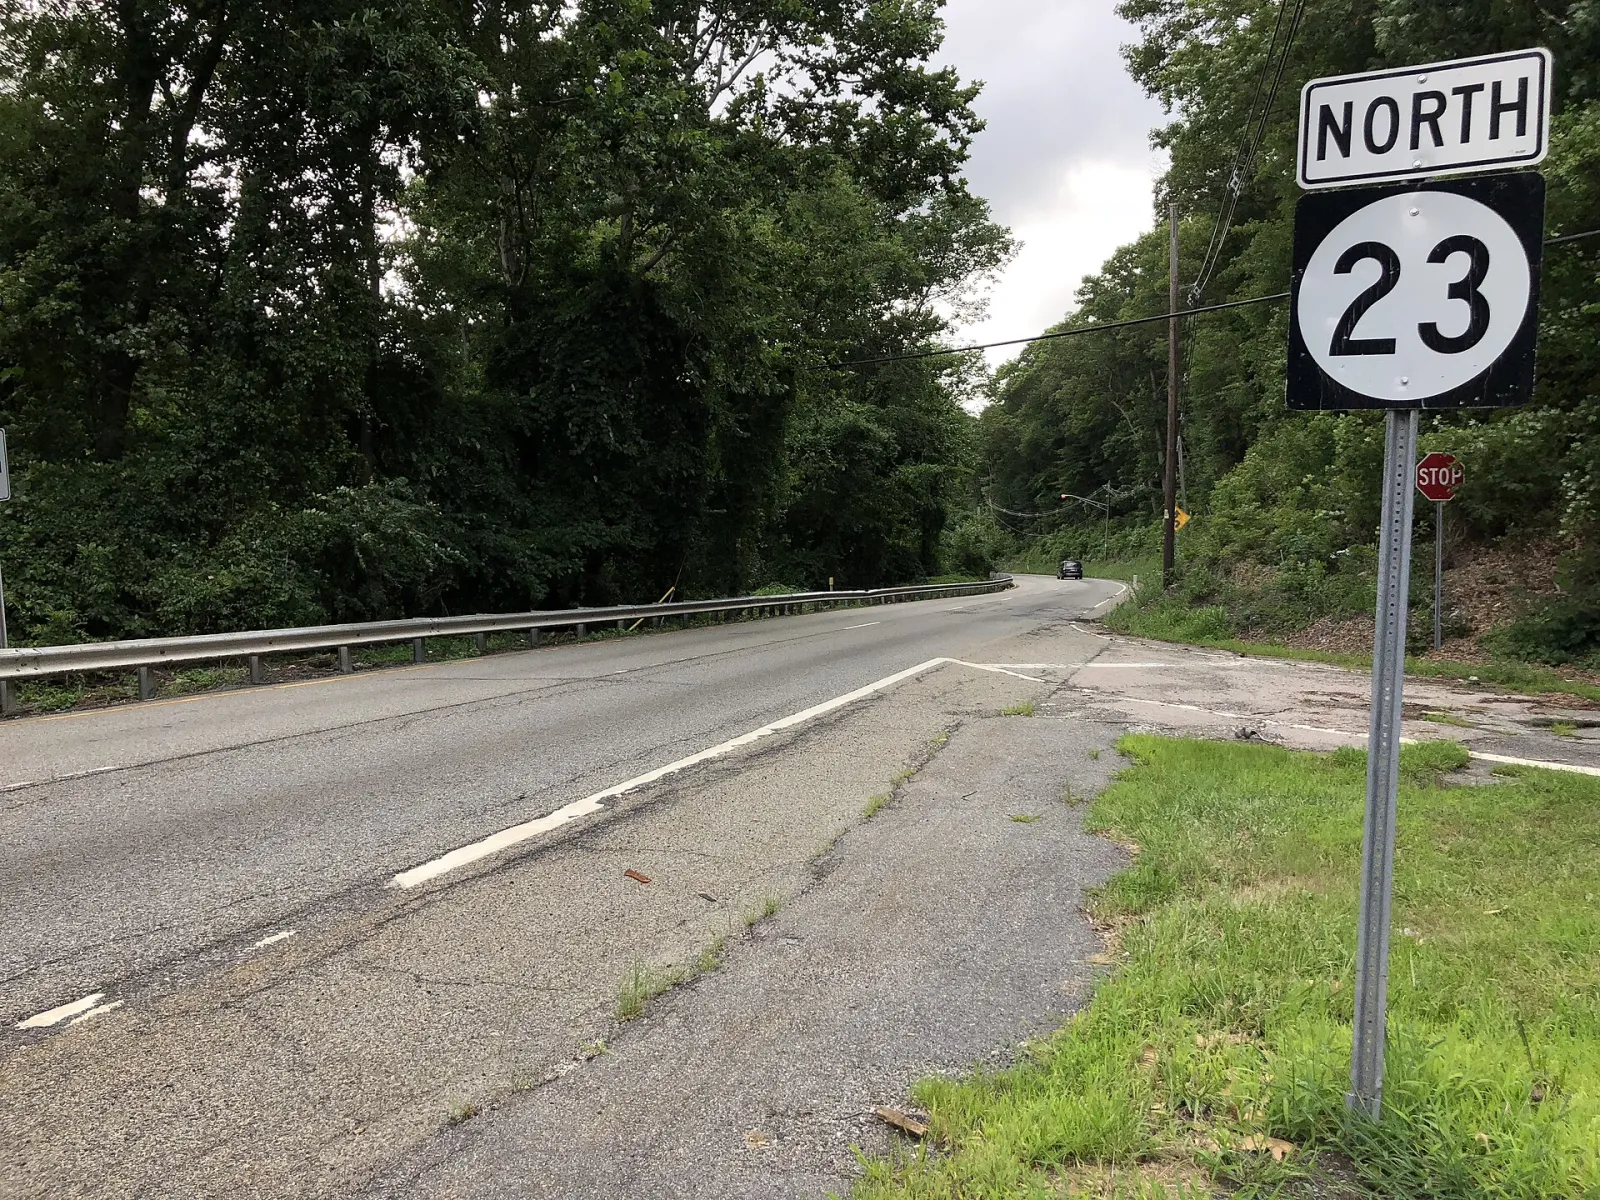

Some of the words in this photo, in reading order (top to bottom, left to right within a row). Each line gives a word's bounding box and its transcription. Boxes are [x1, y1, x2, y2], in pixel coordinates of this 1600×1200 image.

[1316, 76, 1529, 161] NORTH
[1329, 234, 1491, 356] 23
[1419, 467, 1462, 485] STOP
